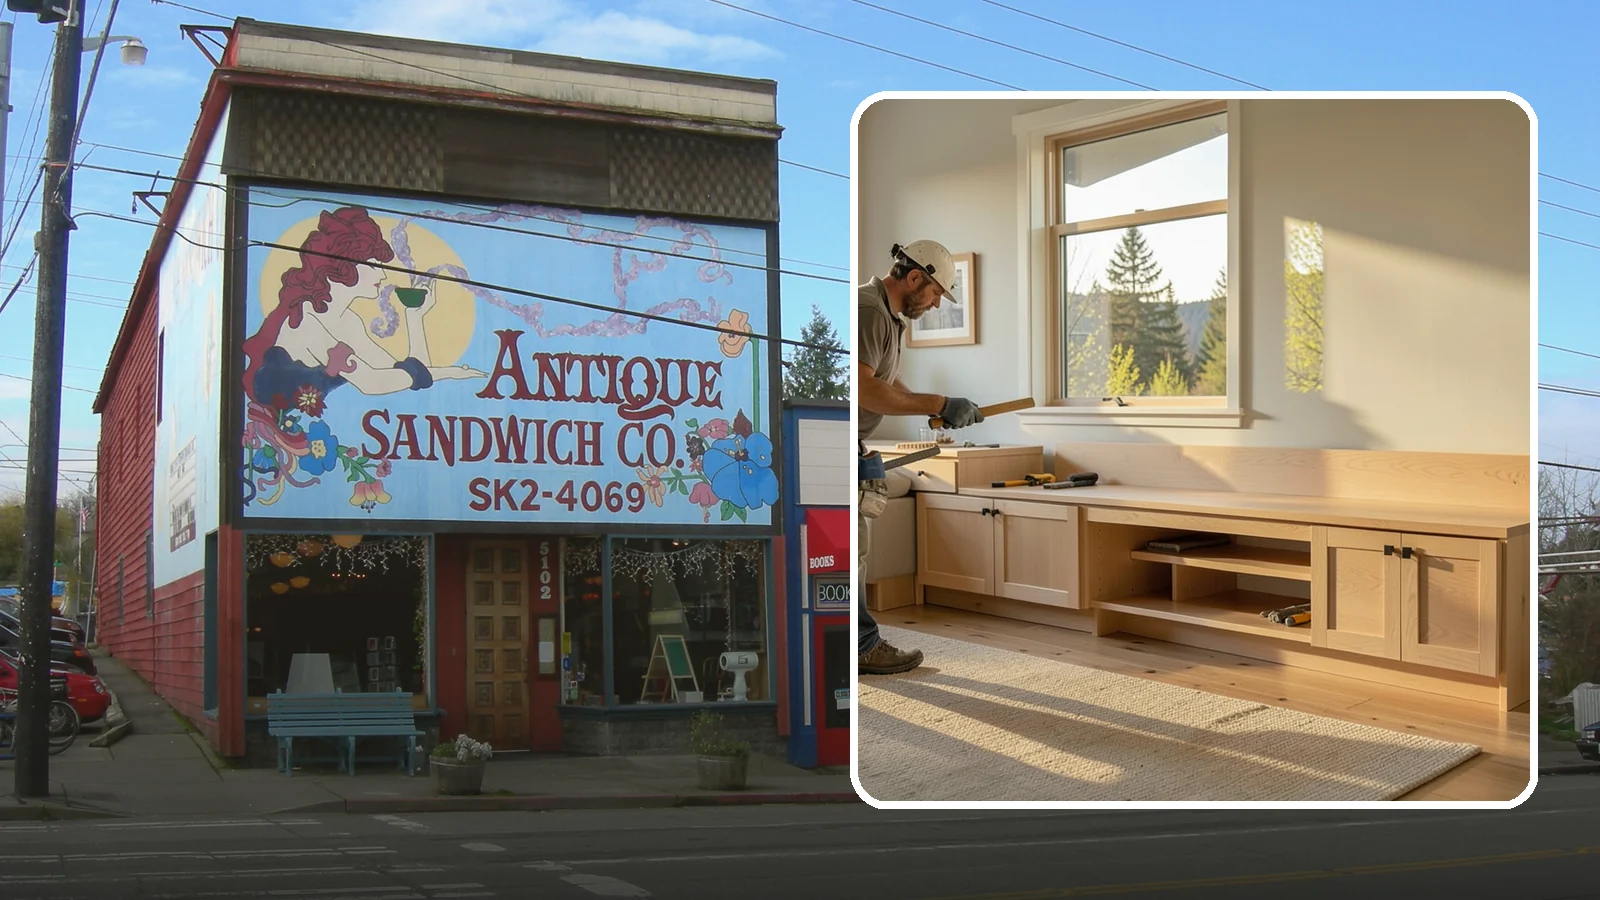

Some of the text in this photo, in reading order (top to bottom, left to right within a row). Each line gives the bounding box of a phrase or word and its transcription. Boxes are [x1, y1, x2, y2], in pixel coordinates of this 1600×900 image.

[476, 329, 723, 420] ANTIQUE
[361, 409, 684, 469] SANDWICH CO.
[468, 477, 645, 512] SK2-4069
[540, 541, 551, 600] 5102
[809, 555, 835, 569] BOOKS
